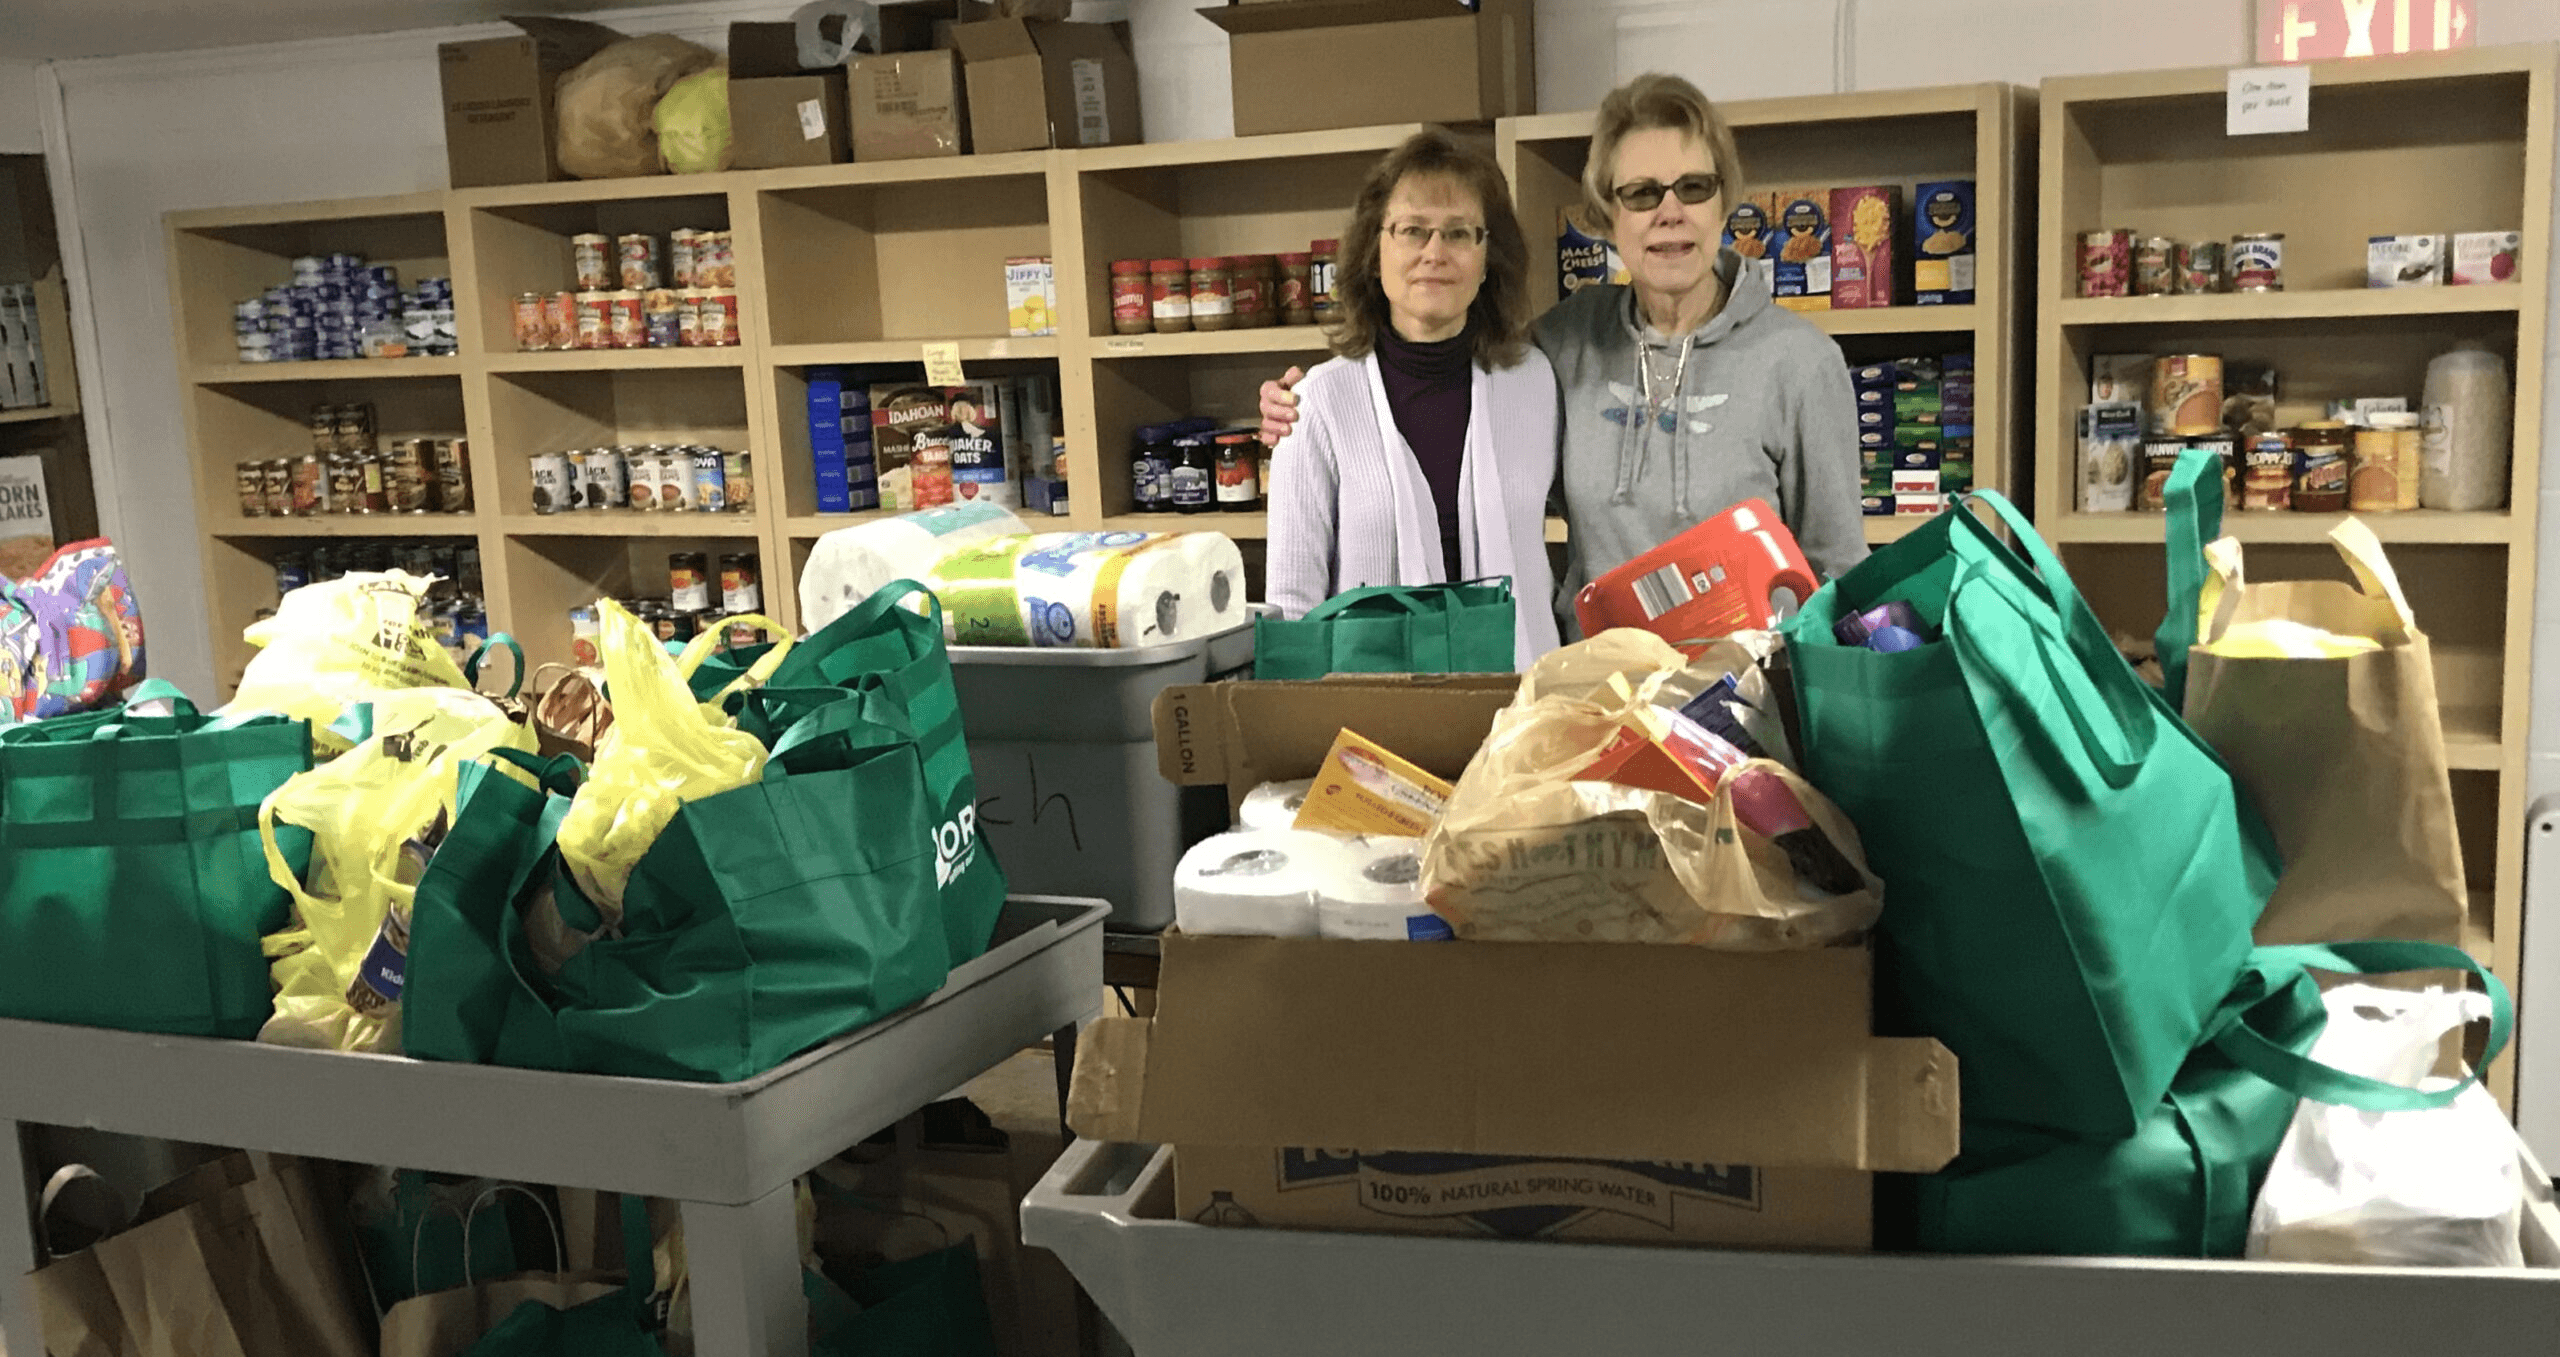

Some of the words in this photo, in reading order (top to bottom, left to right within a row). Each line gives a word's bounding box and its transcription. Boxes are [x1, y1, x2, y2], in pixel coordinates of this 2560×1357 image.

[888, 404, 945, 425] IDAHOAN
[911, 432, 950, 452] Bruce
[950, 438, 993, 453] UAKER
[953, 452, 982, 464] OATS
[1174, 706, 1197, 774] GALLON
[1369, 1181, 1432, 1206] 100%
[1441, 1179, 1522, 1203] NATURAL
[1526, 1176, 1593, 1195] SPRING
[1599, 1181, 1656, 1207] WATER
